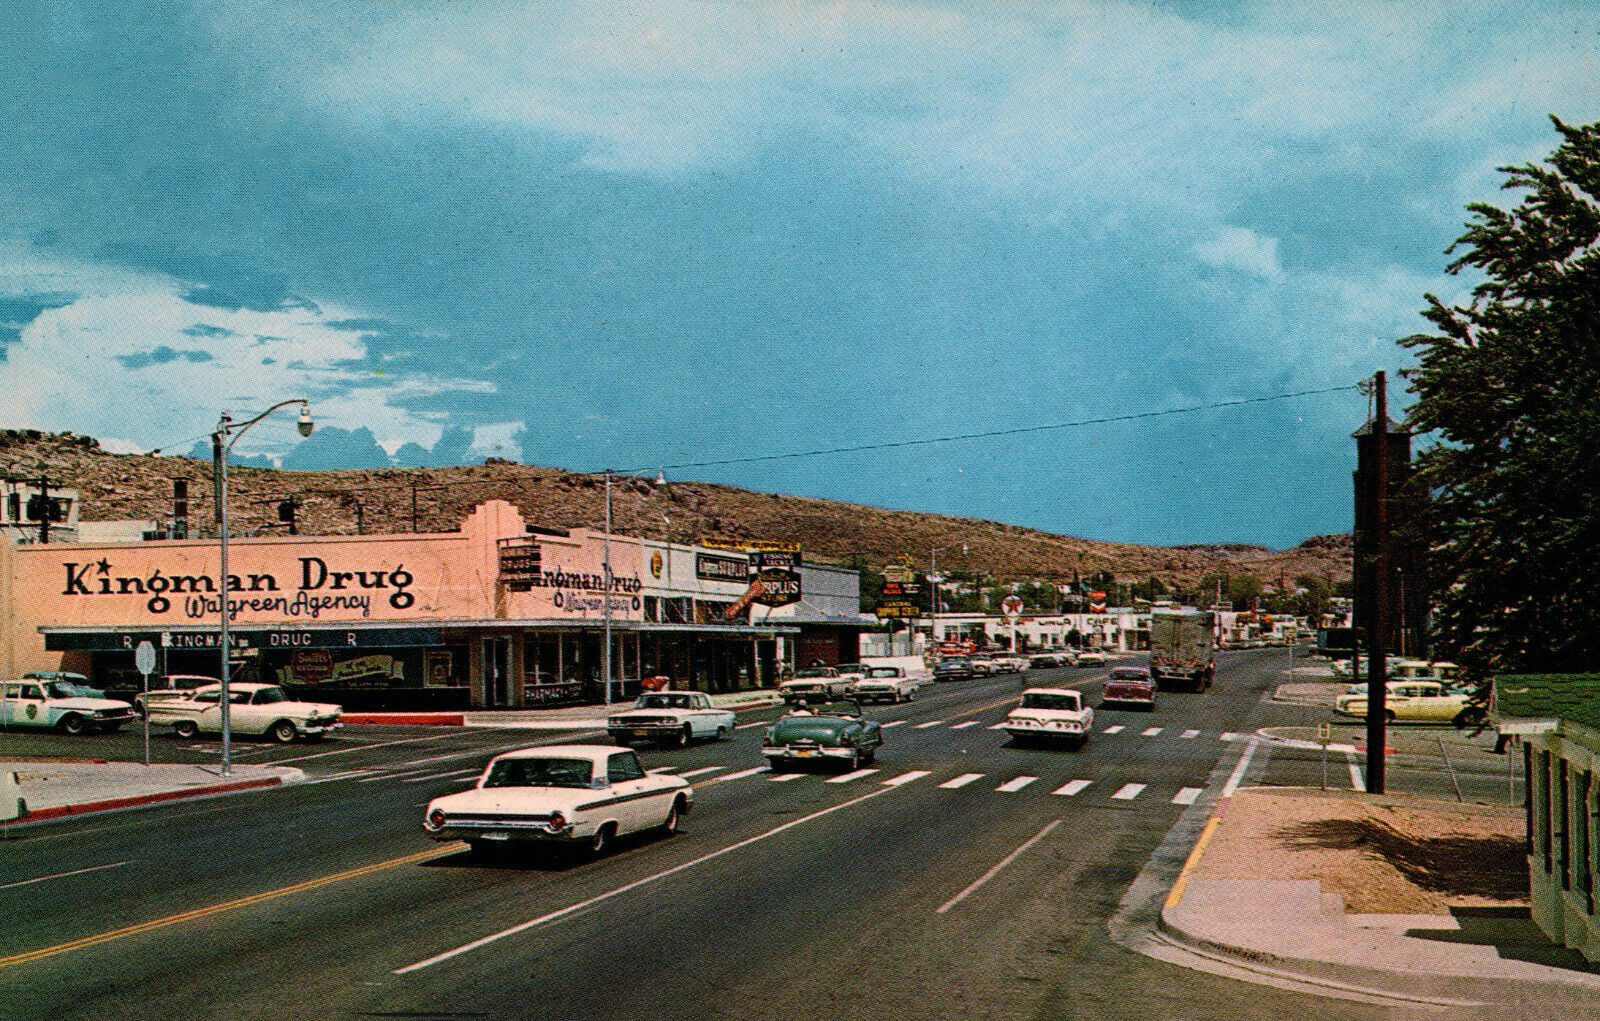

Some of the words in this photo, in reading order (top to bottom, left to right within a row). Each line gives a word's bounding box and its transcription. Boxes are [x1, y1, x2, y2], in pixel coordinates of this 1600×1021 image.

[62, 560, 280, 614] Kingman
[298, 557, 415, 610] Drug
[764, 580, 799, 595] RPLUS
[185, 595, 287, 620] Walgreen
[289, 591, 371, 619] Agency
[1086, 617, 1118, 625] CAFE
[270, 633, 312, 647] DRUG
[347, 632, 357, 647] R
